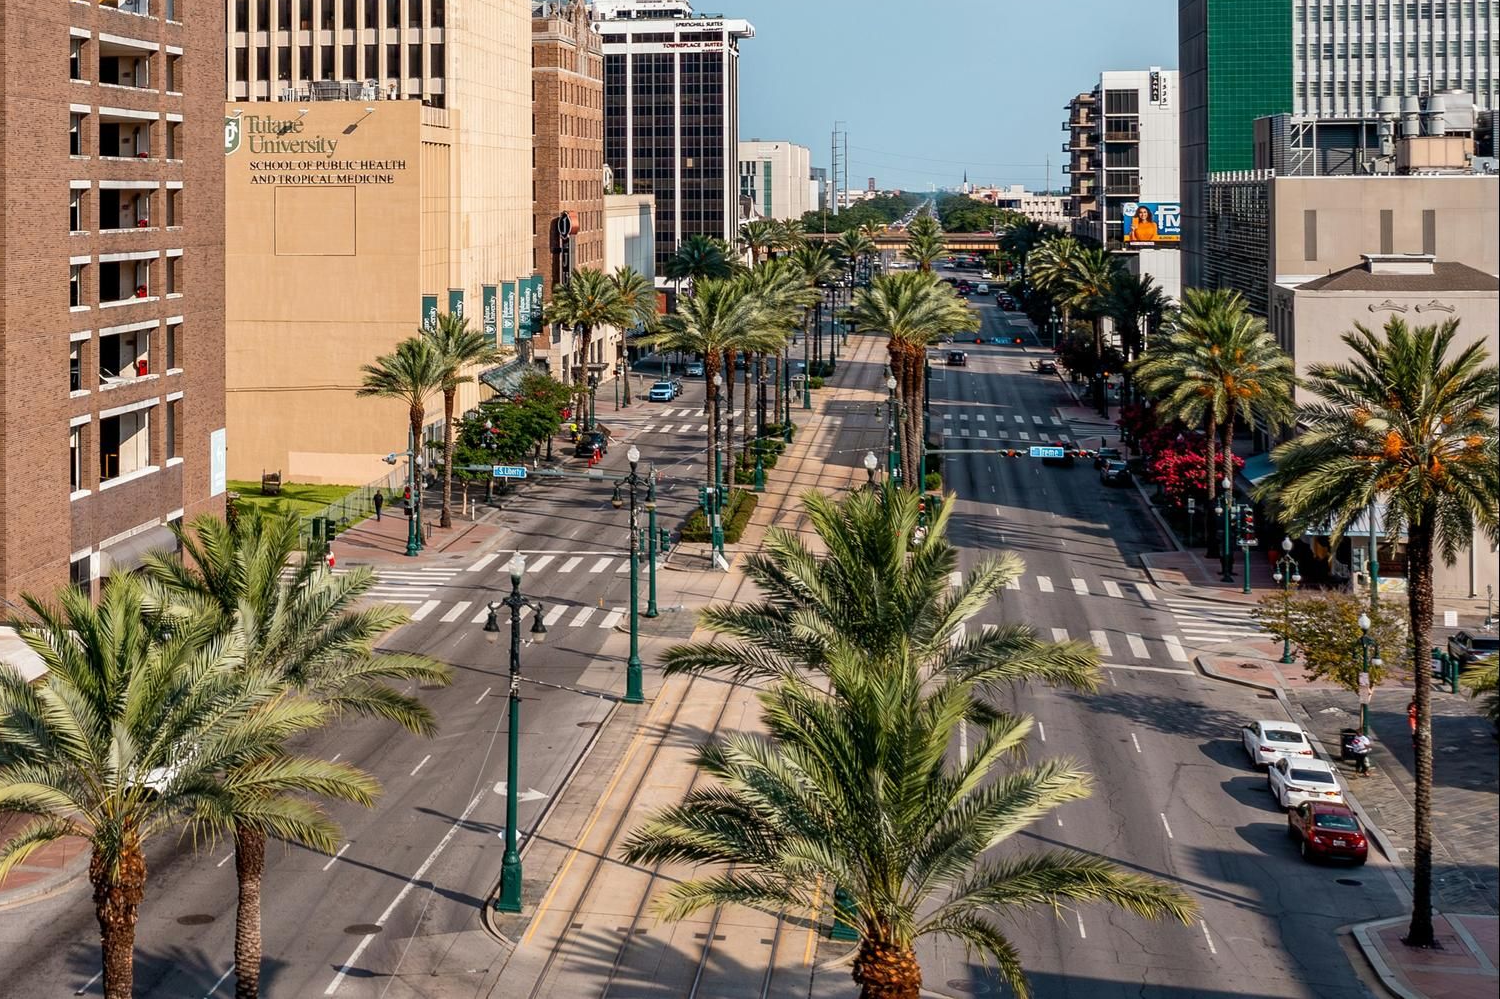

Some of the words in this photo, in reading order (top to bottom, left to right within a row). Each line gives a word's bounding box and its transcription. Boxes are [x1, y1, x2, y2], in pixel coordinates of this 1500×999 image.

[244, 115, 304, 134] Tulane
[248, 135, 338, 158] University
[250, 160, 295, 170] SCHOOL
[298, 160, 313, 170] OF
[316, 160, 357, 170] PUBLIC
[360, 160, 406, 170] HEALTH
[250, 174, 276, 184] AND
[277, 174, 334, 184] TROPICAL
[337, 174, 394, 184] MEDICINE
